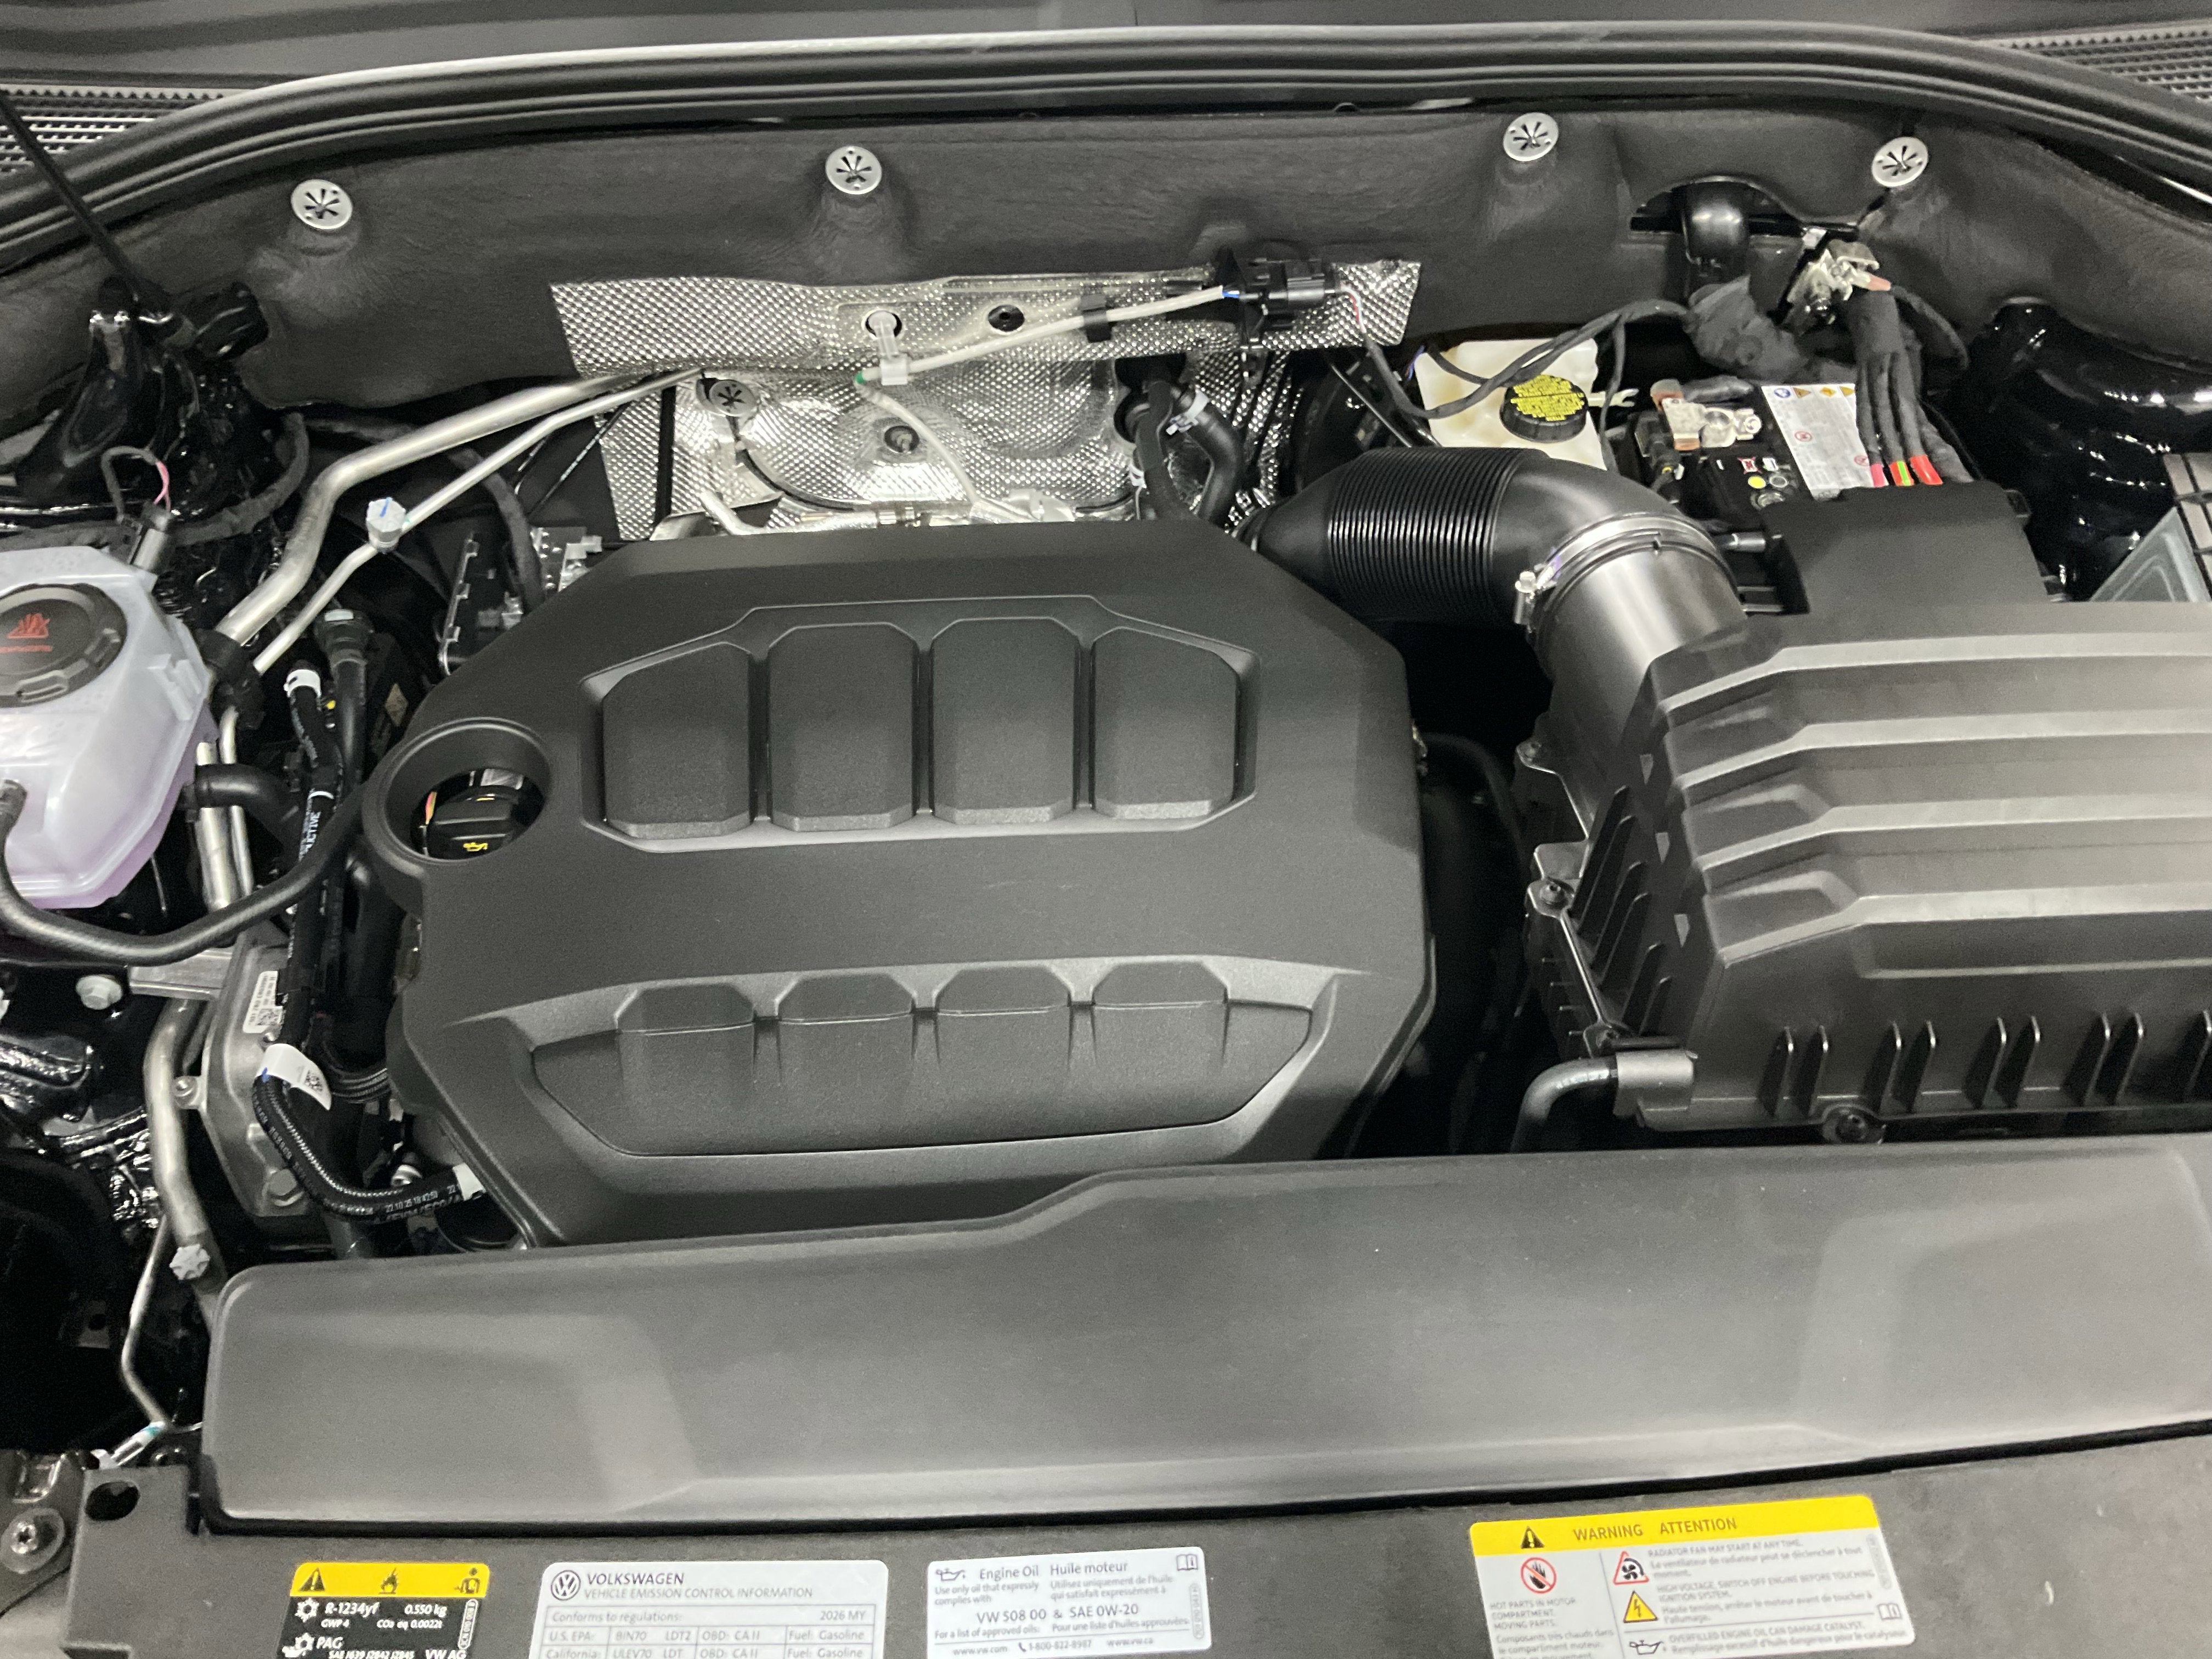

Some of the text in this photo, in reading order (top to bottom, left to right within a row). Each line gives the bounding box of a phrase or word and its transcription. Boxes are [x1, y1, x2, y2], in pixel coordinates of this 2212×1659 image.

[1573, 1517, 1737, 1541] WARNING ATTENTION
[1648, 1548, 1688, 1558] RADIATOR
[1690, 1546, 1706, 1555] FAN
[1708, 1544, 1724, 1553] MAY
[1727, 1542, 1750, 1552] START
[1764, 1540, 1779, 1549] ANY
[980, 1565, 1039, 1582] Engine Oil
[1050, 1561, 1128, 1575] Huile moteur
[586, 1573, 685, 1585] VOLKSWAGEN
[1051, 1579, 1081, 1589] Utilisez
[1083, 1577, 1135, 1588] uniquement
[1137, 1576, 1147, 1584] de
[1752, 1577, 1765, 1586] OFF
[1768, 1575, 1798, 1585] ENGINE
[584, 1588, 813, 1599] VEHICLE EMISSION CONTROL INFORMATION
[935, 1581, 1039, 1595] Use only oil that expressly
[1051, 1584, 1166, 1602] qui satisfait expressément à
[935, 1595, 971, 1607] complies
[1491, 1597, 1576, 1610] HOT PARTS IN MOTOR
[325, 1601, 380, 1618] R-1234yf
[405, 1603, 448, 1618] 0.550 kg
[977, 1603, 1139, 1624] VW 508 00 & SAE 0W-20
[552, 1611, 603, 1622] Conforms
[606, 1612, 615, 1622] to
[820, 1610, 866, 1621] 2026 MY
[320, 1619, 349, 1628] GWP 4
[397, 1620, 408, 1630] eq
[1052, 1622, 1071, 1632] Pour
[1073, 1622, 1087, 1630] une
[1090, 1620, 1106, 1630] liste
[1494, 1621, 1527, 1630] MOVING
[549, 1631, 568, 1641] U.S.
[614, 1630, 691, 1641] BIN70 LDT2
[735, 1630, 749, 1640] CA
[819, 1629, 864, 1640] Gasoline
[935, 1630, 949, 1639] For
[957, 1628, 969, 1638] list
[972, 1627, 981, 1637] of
[984, 1624, 1021, 1638] approved
[1496, 1633, 1546, 1644] Composants
[1565, 1629, 1593, 1639] chauds
[1594, 1627, 1614, 1637] dans
[317, 1636, 343, 1649] PAG
[1107, 1637, 1154, 1647] www.vw.ca
[613, 1648, 683, 1659] ULEV70 LDT
[733, 1648, 747, 1658] CA
[817, 1647, 862, 1658] Gasoline
[953, 1645, 1008, 1656] www.vw.com
[1508, 1642, 1568, 1654] compartiment
[329, 1650, 345, 1659] SAE
[425, 1649, 467, 1659] VW AG
